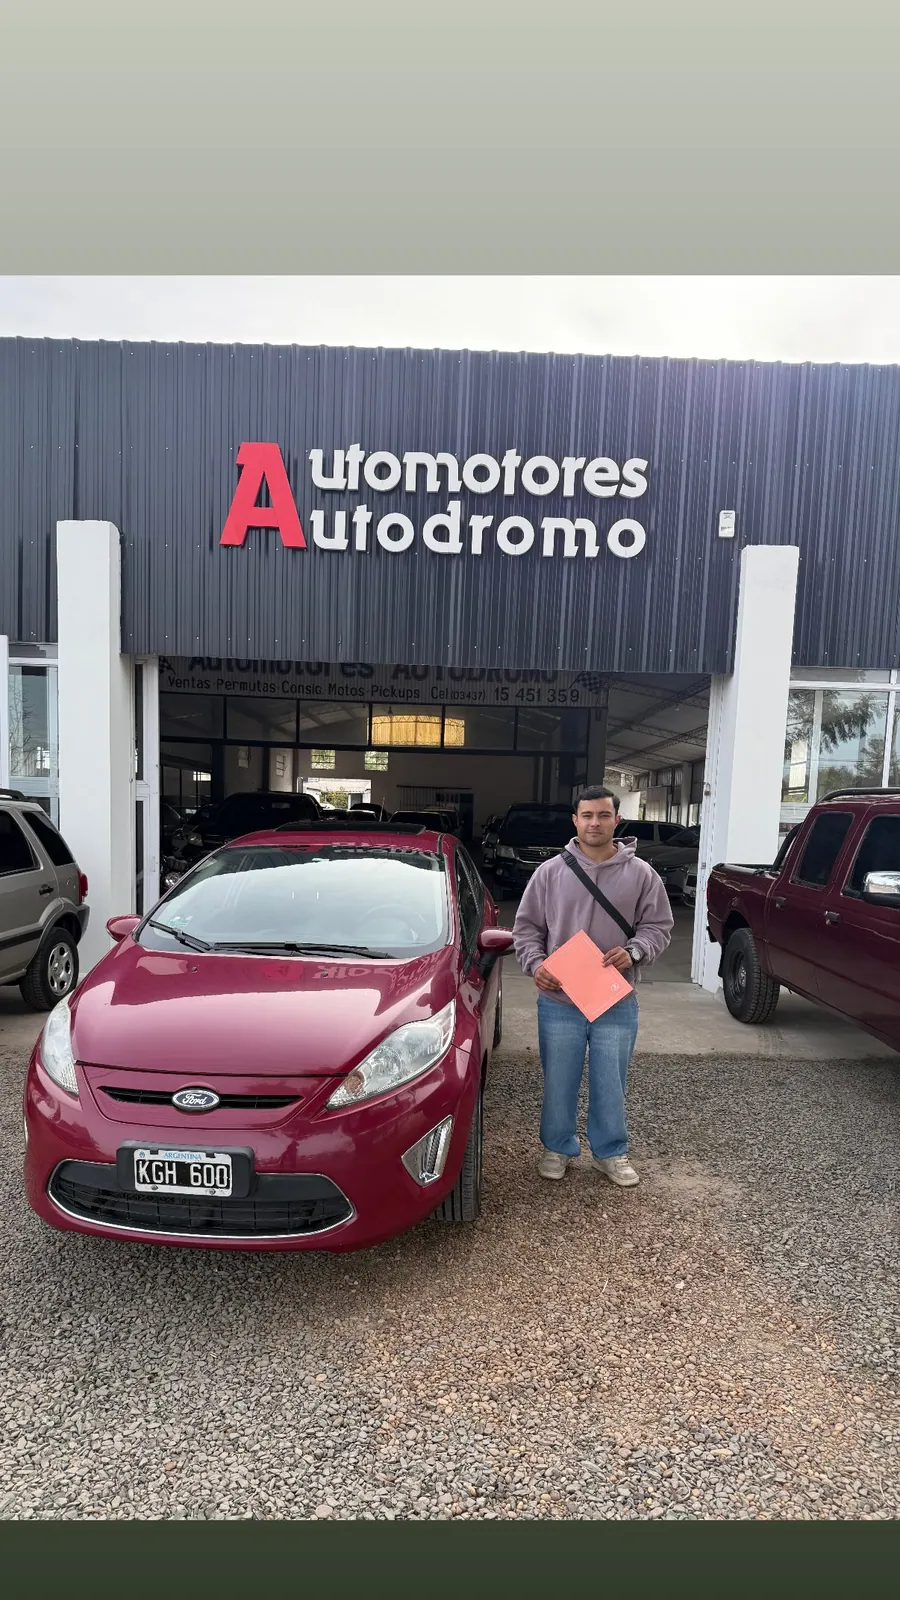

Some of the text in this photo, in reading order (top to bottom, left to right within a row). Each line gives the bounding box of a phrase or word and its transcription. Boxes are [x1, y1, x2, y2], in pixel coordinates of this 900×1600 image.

[168, 675, 211, 690] Ventas
[216, 678, 276, 693] Permutas
[328, 683, 365, 697] Motos
[371, 685, 421, 701] Pickups
[494, 686, 509, 702] 15
[547, 688, 580, 703] 359
[182, 1092, 208, 1105] Ford
[163, 1151, 202, 1161] ARGENTINA
[137, 1160, 229, 1189] KGH 600
